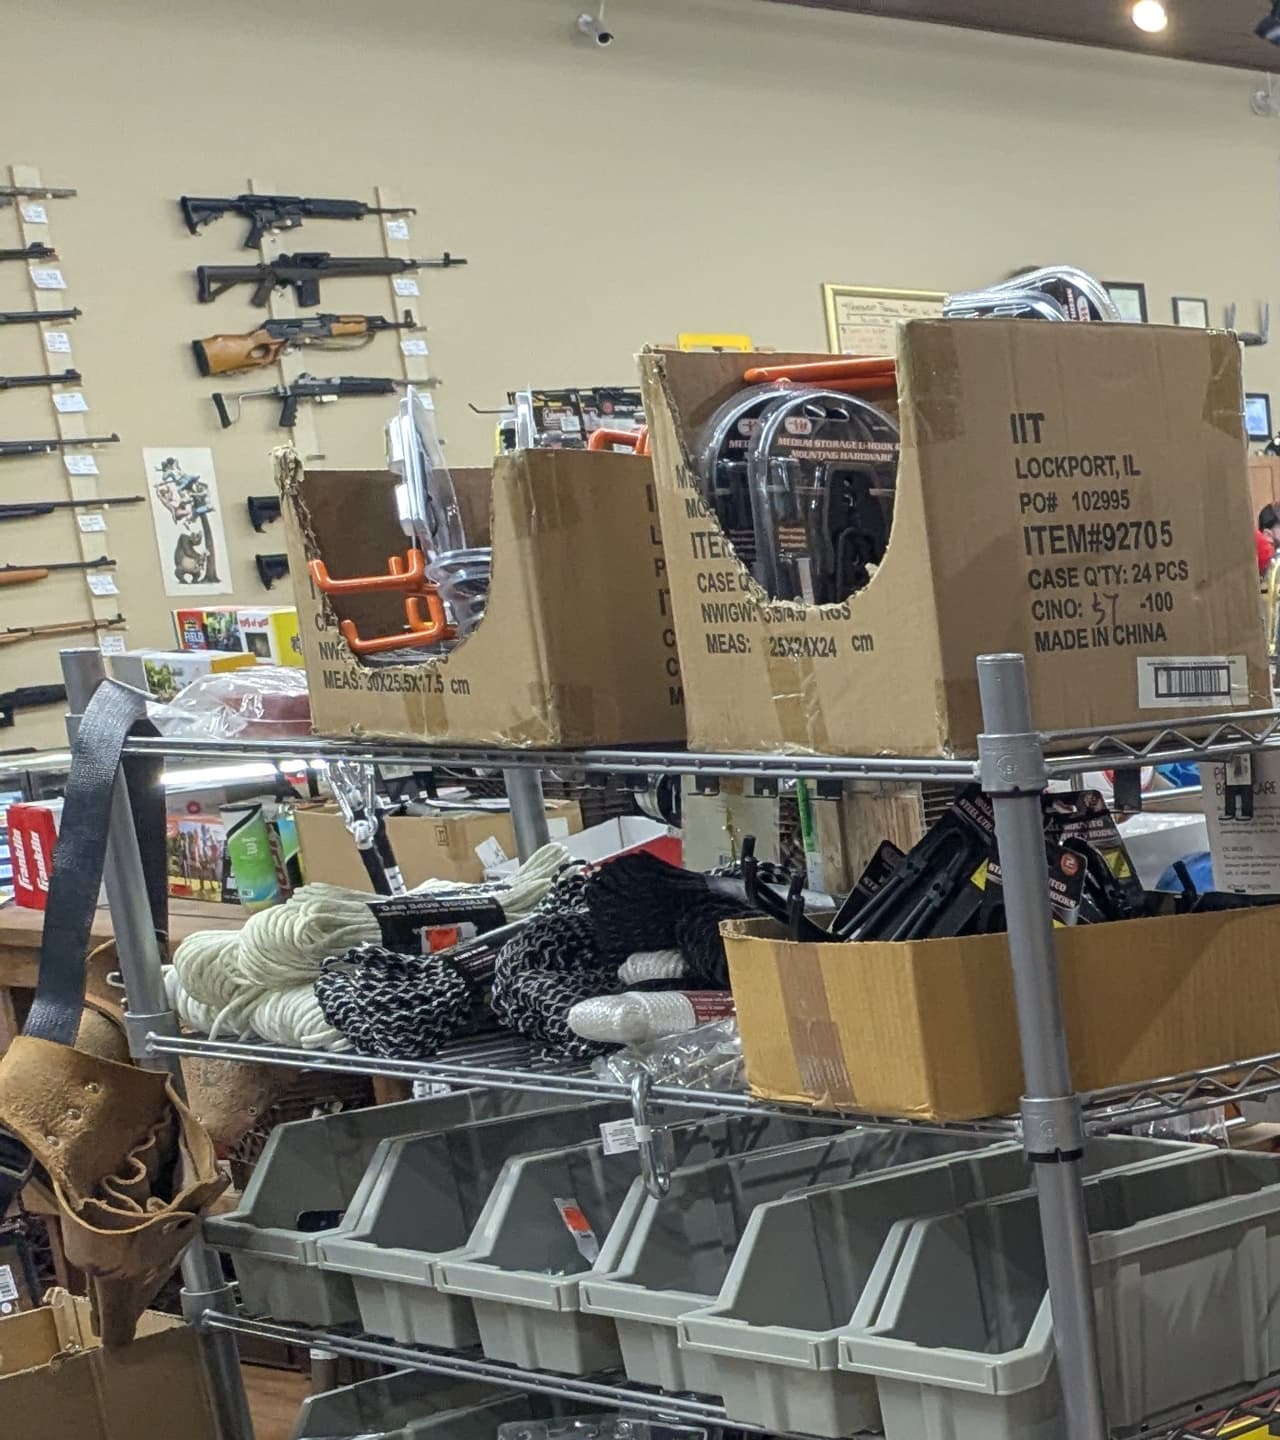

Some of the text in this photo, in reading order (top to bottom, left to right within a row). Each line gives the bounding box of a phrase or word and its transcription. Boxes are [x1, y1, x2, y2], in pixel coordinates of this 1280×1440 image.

[1010, 412, 1046, 444] IIT
[813, 438, 854, 450] STORAGE
[1015, 455, 1141, 480] LOCKPORT, IL
[1019, 489, 1131, 514] PO# 102995
[1025, 520, 1173, 556] ITEM#92705
[696, 571, 734, 594] CASE
[1028, 568, 1079, 590] CASE
[1133, 563, 1152, 583] 24
[1155, 560, 1189, 582] PCS
[1140, 591, 1174, 613] -100
[184, 632, 204, 643] FIELD
[706, 632, 874, 659] MEAS: 25X24X24 cm
[1035, 621, 1167, 653] MADE IN CHINA
[323, 670, 362, 690] MEAS:
[450, 677, 471, 695] cm
[12, 828, 33, 891] Franklin
